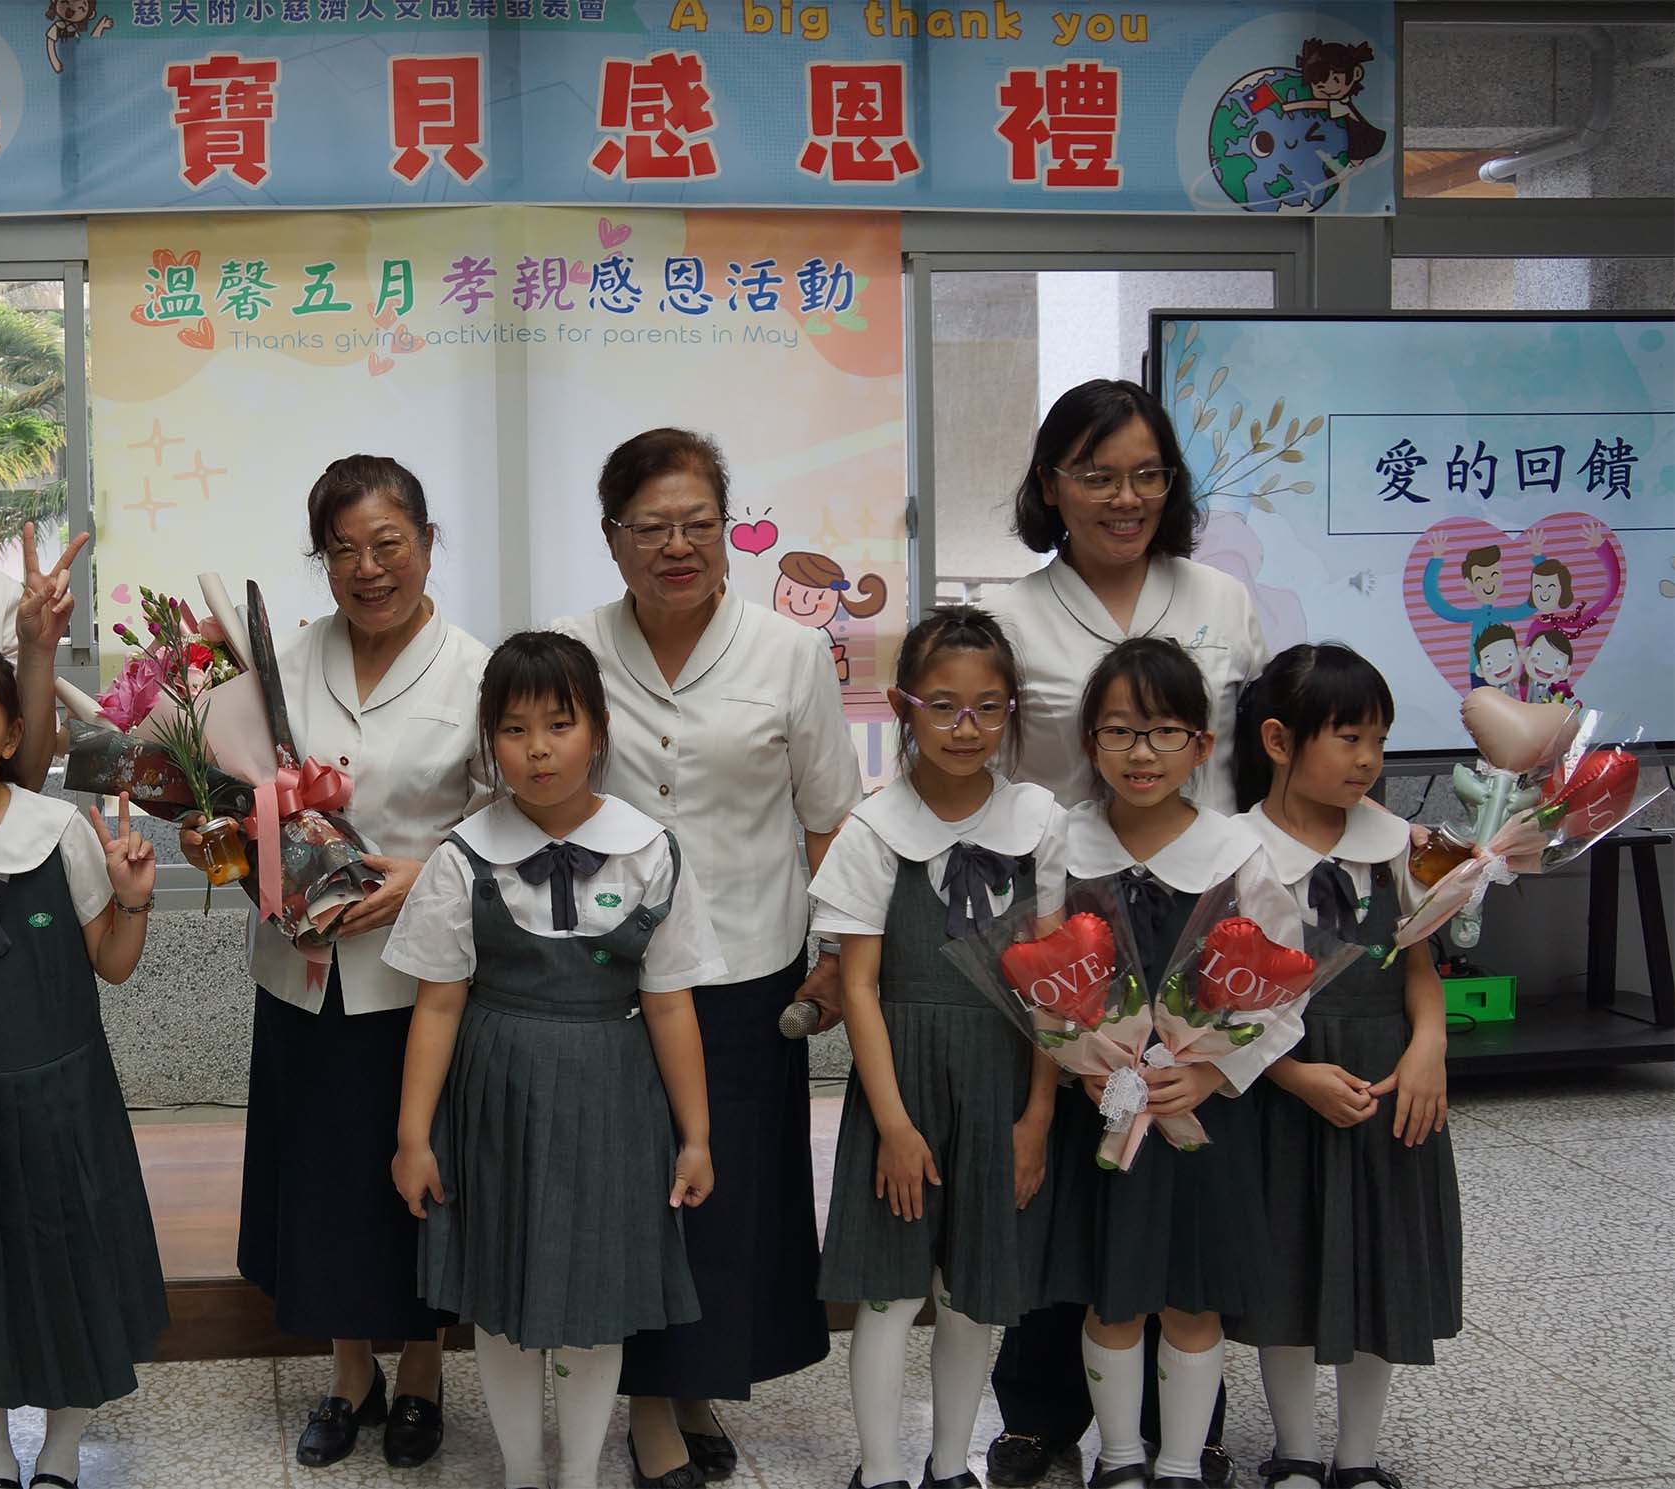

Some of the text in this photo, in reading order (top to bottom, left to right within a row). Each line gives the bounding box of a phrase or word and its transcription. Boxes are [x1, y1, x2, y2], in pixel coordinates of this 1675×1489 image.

[133, 0, 605, 25] 慈大附小慈濟人文成果發表會
[668, 0, 1149, 46] A big thank you
[166, 53, 1121, 191] 寶貝感恩禮
[144, 254, 857, 321] 溫馨五月孝親感恩活動
[231, 323, 799, 353] Thanks giving activities for parents in May
[1376, 436, 1639, 504] 愛的回饋
